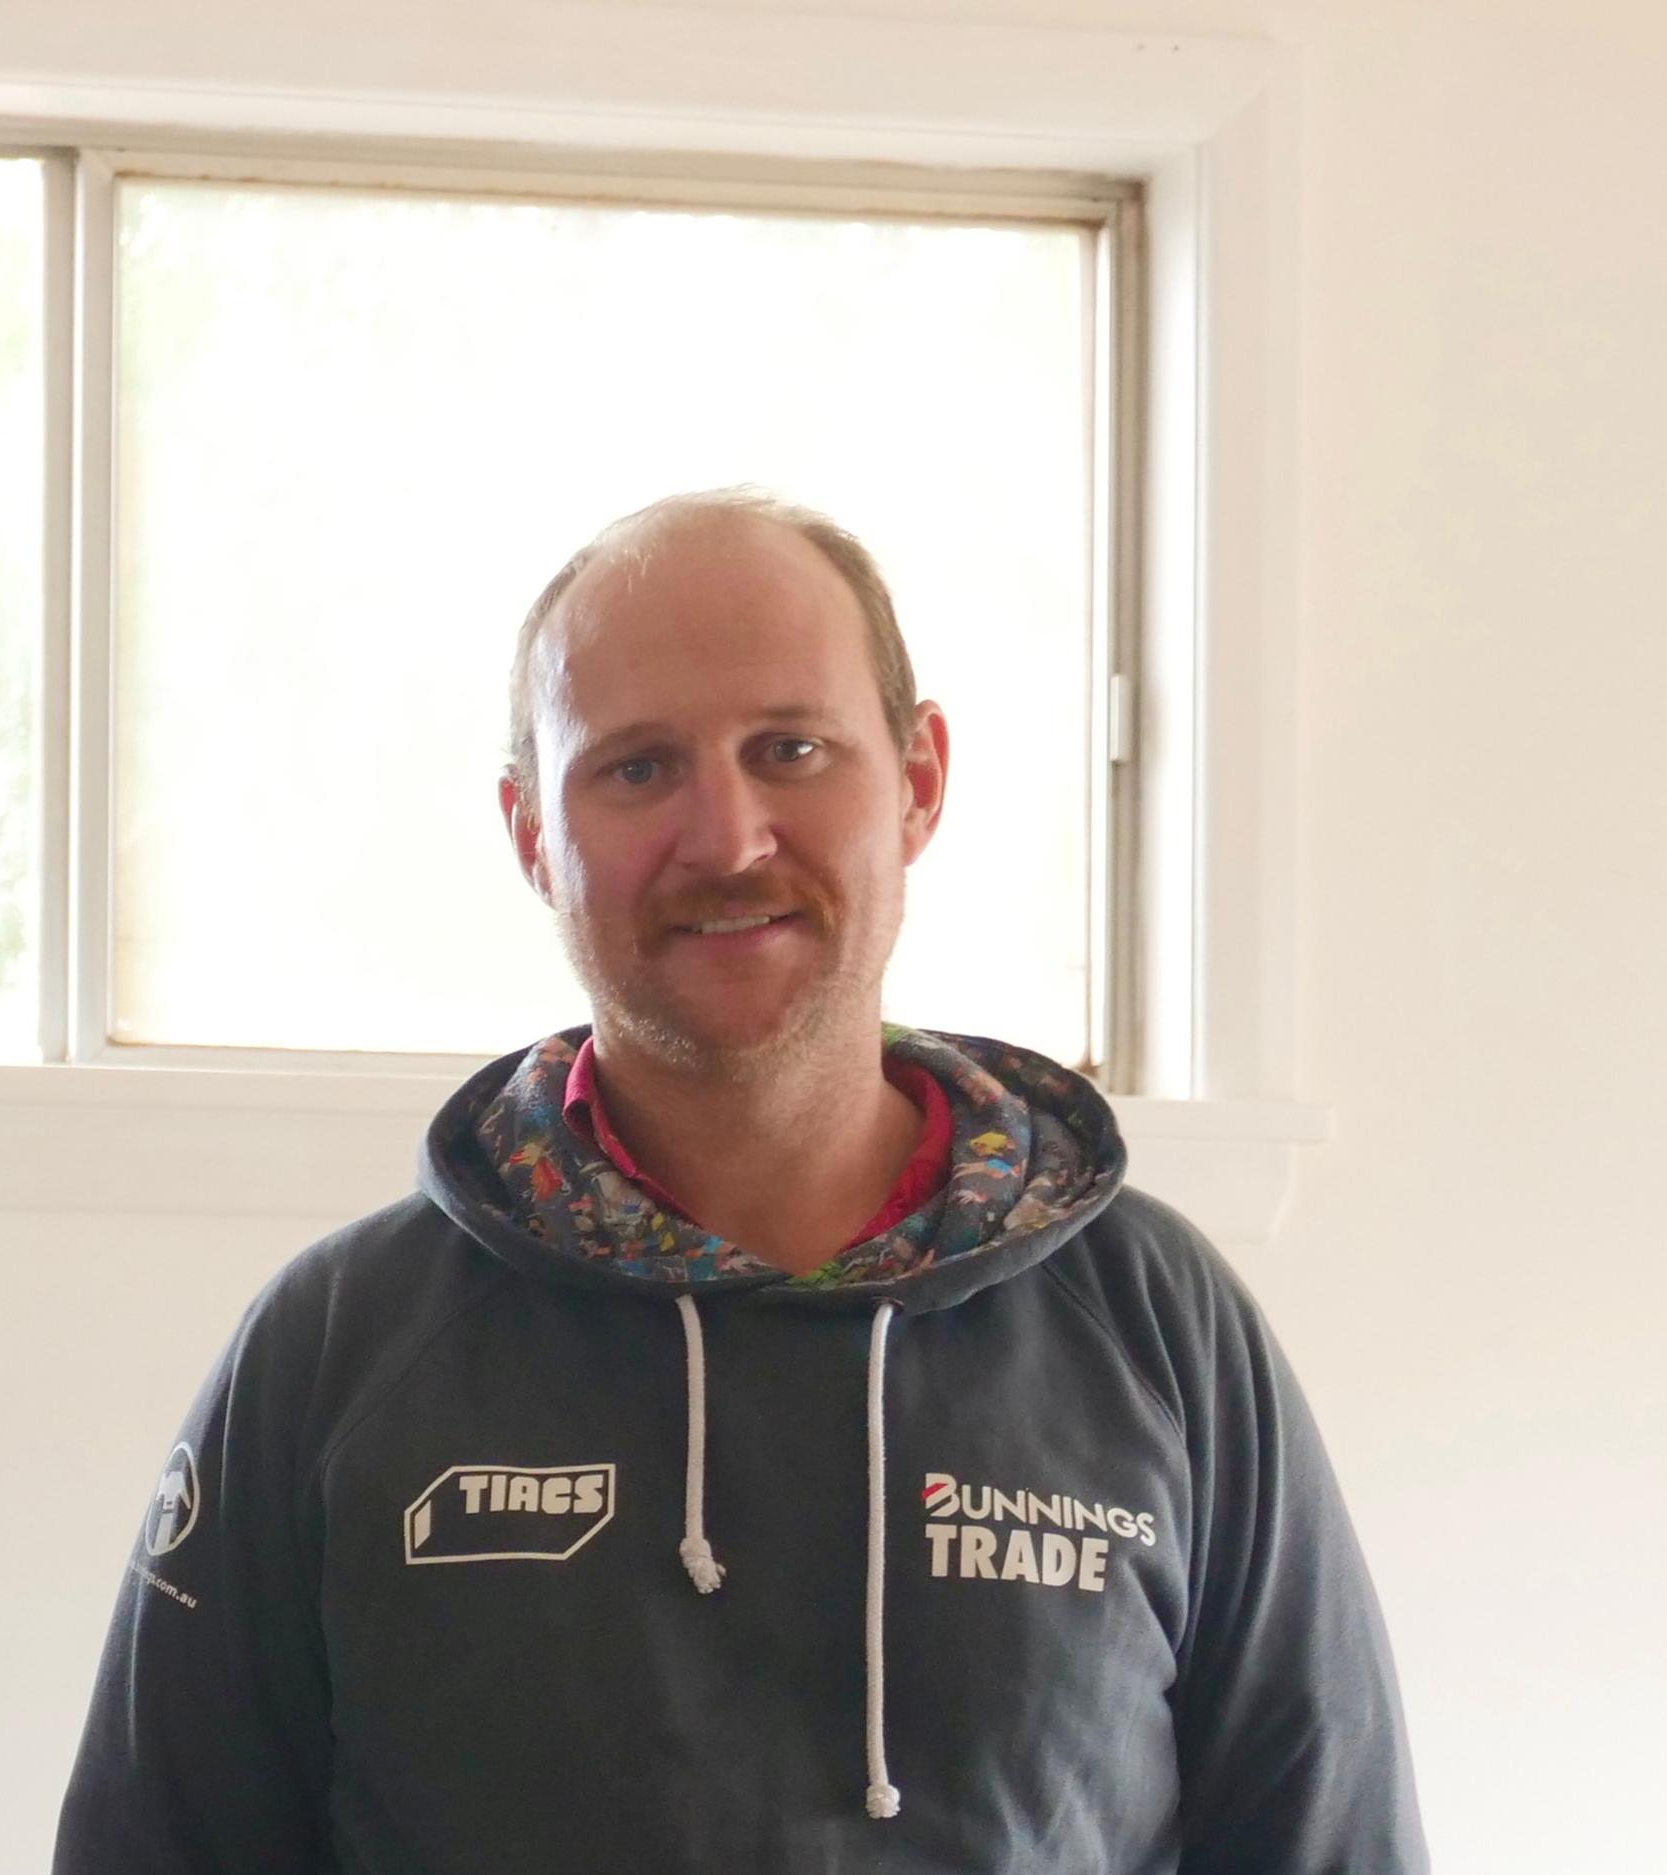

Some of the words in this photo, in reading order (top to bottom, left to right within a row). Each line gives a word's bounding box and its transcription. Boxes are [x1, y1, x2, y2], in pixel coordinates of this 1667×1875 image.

[459, 1474, 604, 1515] TIACS
[922, 1472, 1156, 1547] BUNNINGS
[924, 1523, 1110, 1593] TRADE
